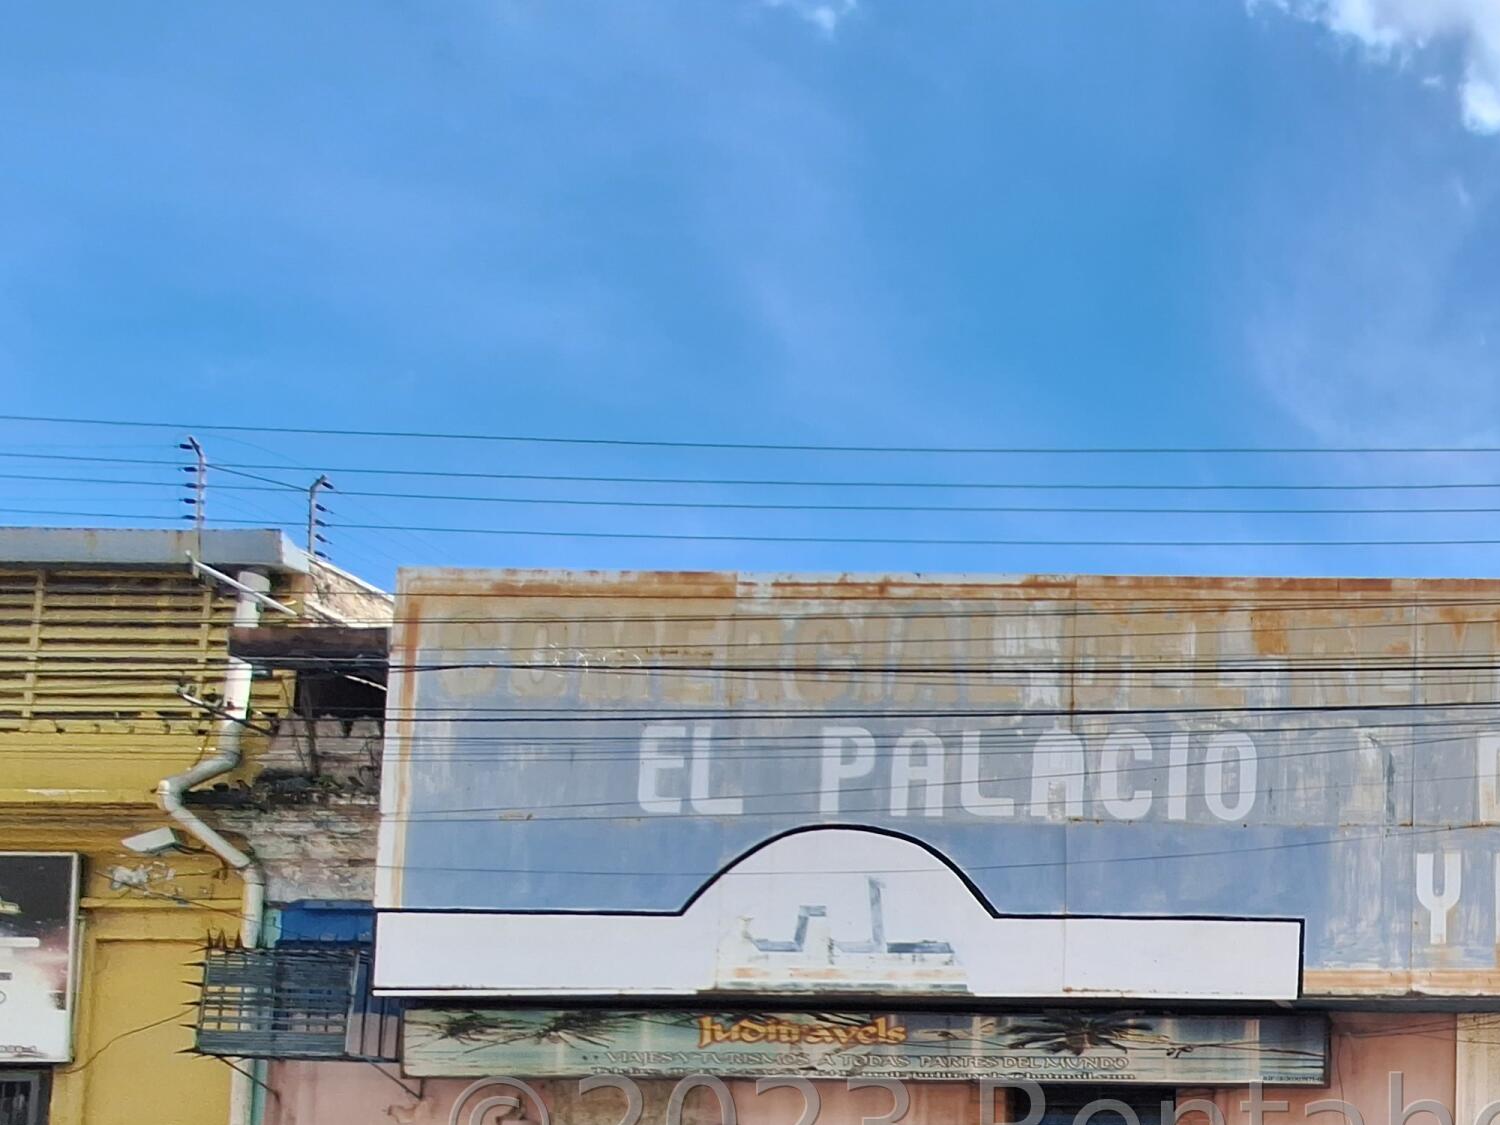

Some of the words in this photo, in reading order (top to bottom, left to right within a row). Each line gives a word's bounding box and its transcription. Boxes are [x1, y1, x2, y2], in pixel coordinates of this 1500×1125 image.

[637, 725, 744, 815] EL
[818, 725, 1258, 820] PALACIO
[1415, 852, 1462, 945] Y
[606, 1051, 673, 1065] VIAJES
[816, 1054, 837, 1068] A
[838, 1054, 911, 1068] TODAS
[919, 1055, 1000, 1070] PARTES
[1002, 1056, 1037, 1070] DEL
[1041, 1056, 1131, 1070] MUNDO
[696, 1014, 908, 1050] Juditravels
